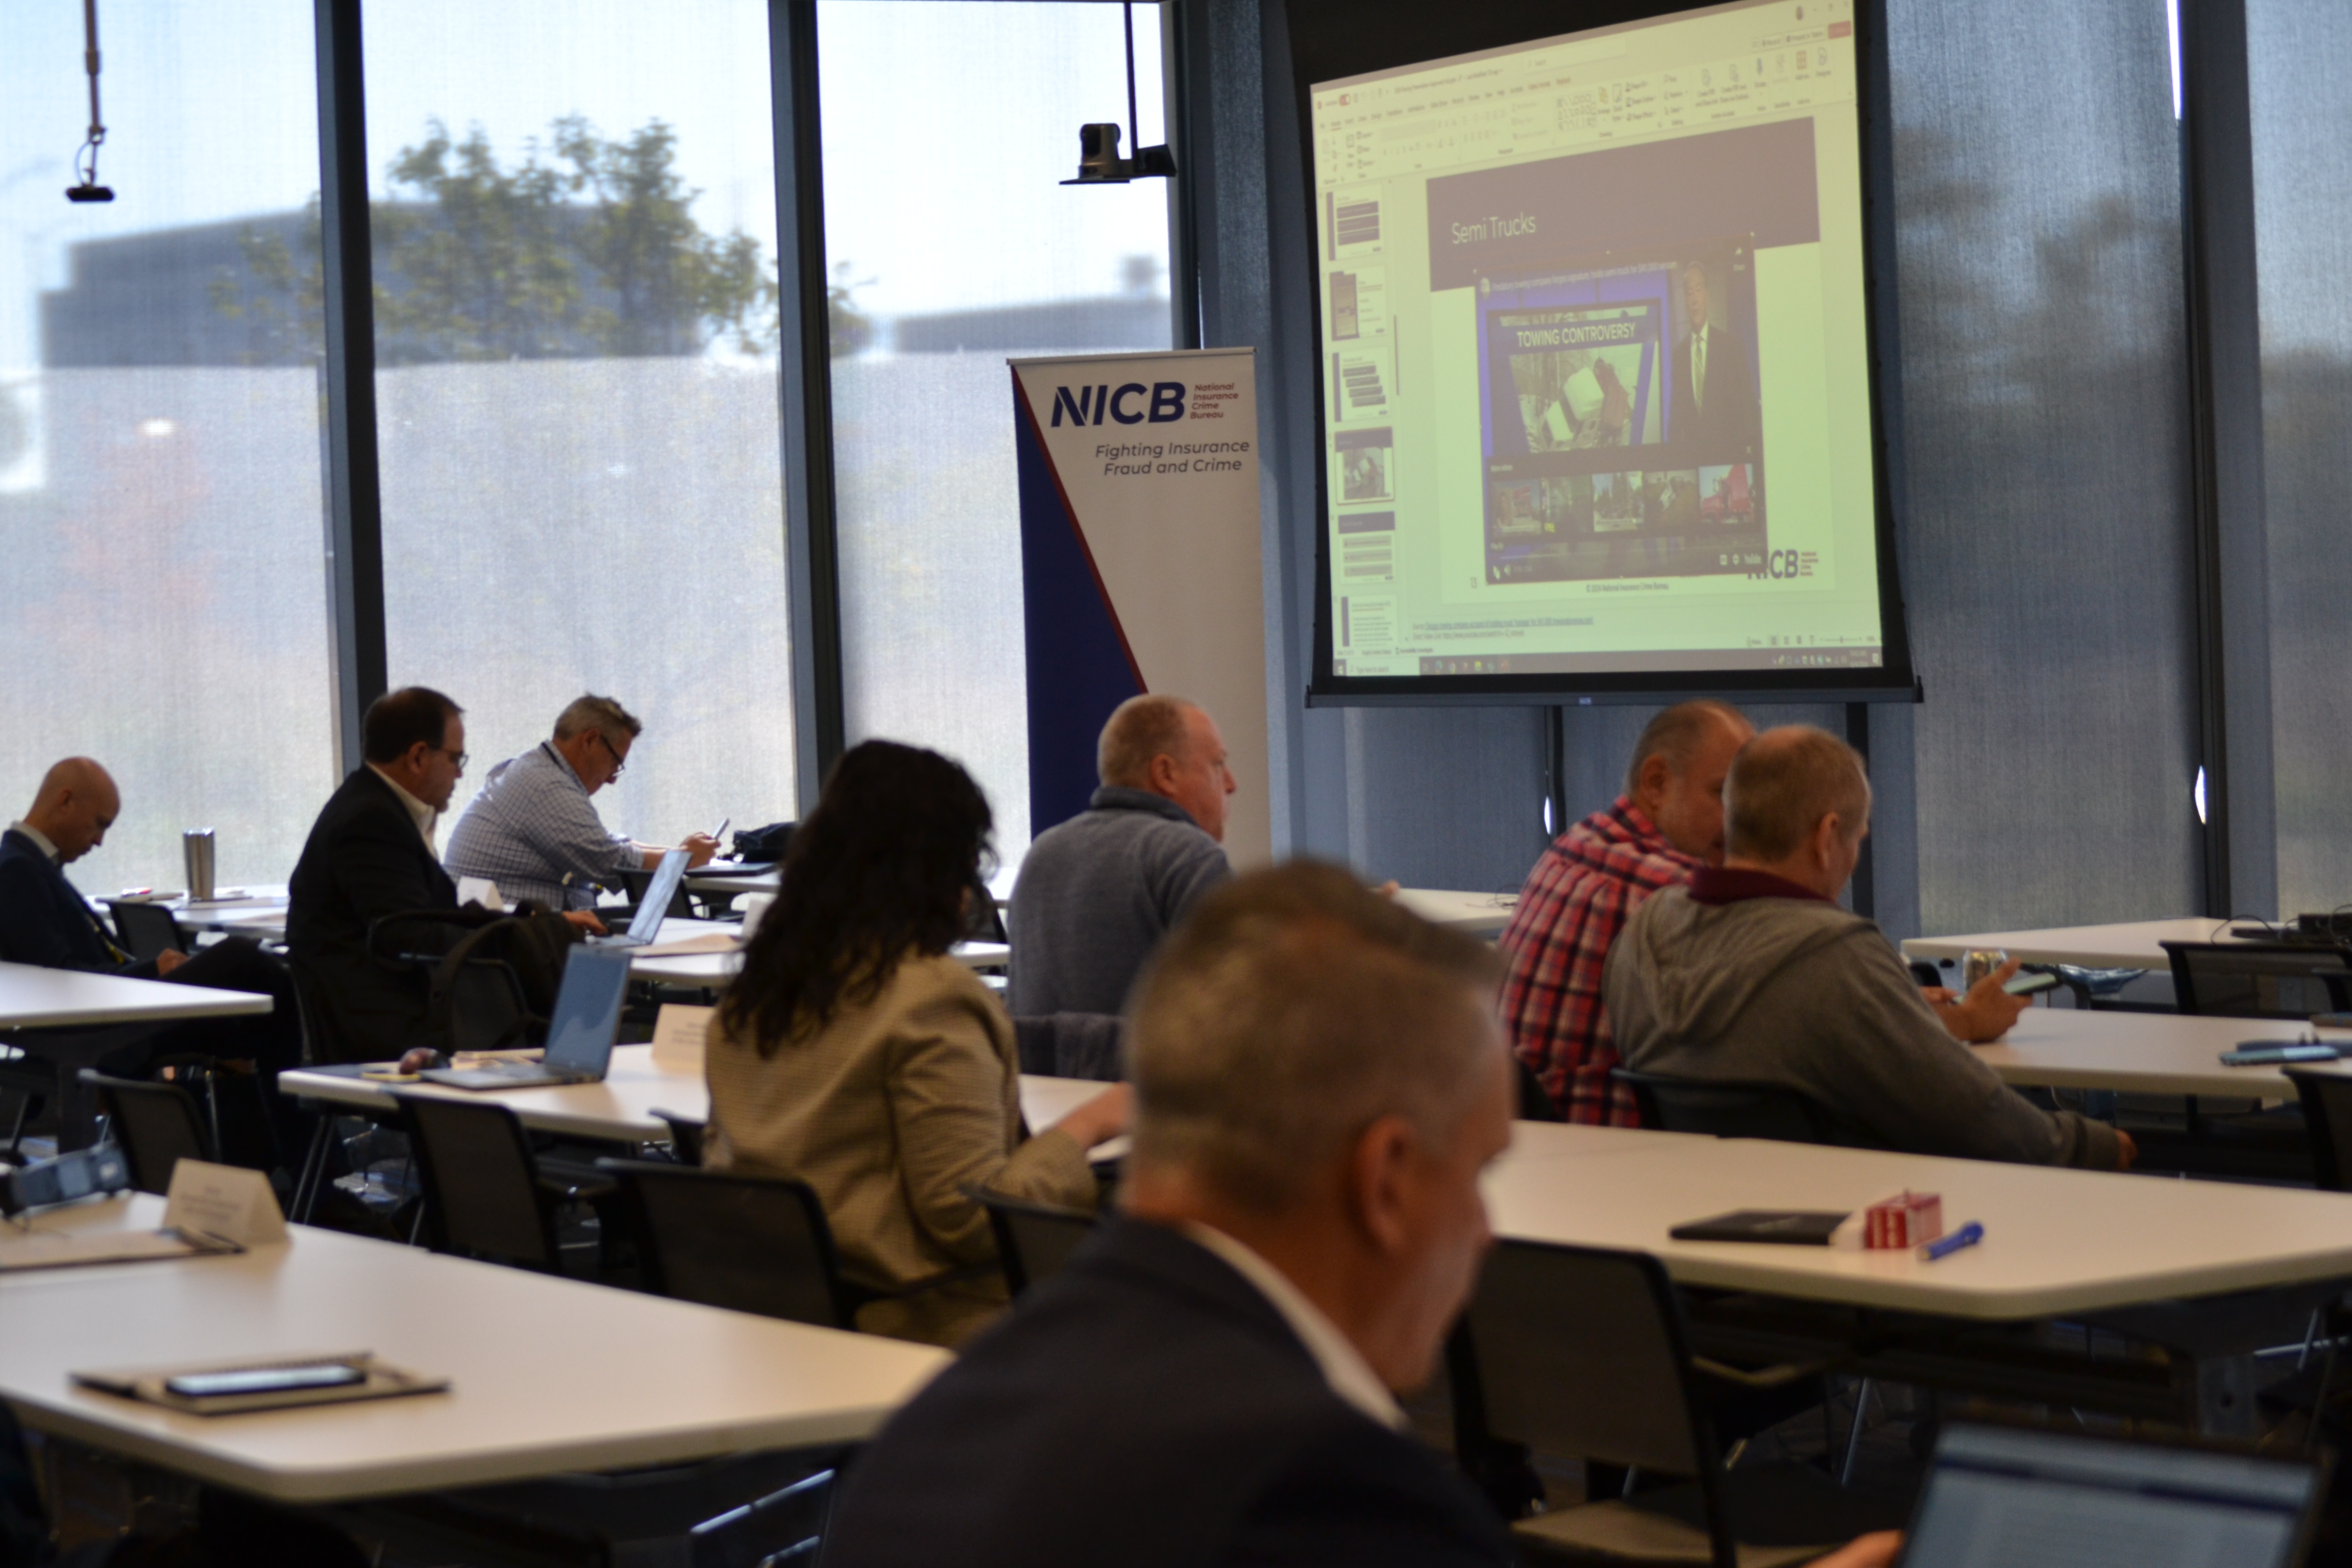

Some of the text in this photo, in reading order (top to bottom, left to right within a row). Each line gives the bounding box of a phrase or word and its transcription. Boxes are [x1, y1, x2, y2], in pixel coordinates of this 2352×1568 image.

[1452, 212, 1536, 244] Semi Trucks
[1517, 322, 1636, 348] TOWING CONTROVERSY
[1194, 383, 1234, 391] National
[1050, 382, 1186, 427] NICB
[1193, 392, 1239, 401] Insurance
[1192, 402, 1219, 410] Crime
[1190, 411, 1223, 420] Bureau
[1095, 441, 1250, 460] Fighting Insurance
[1104, 459, 1242, 476] Fraud and Crime
